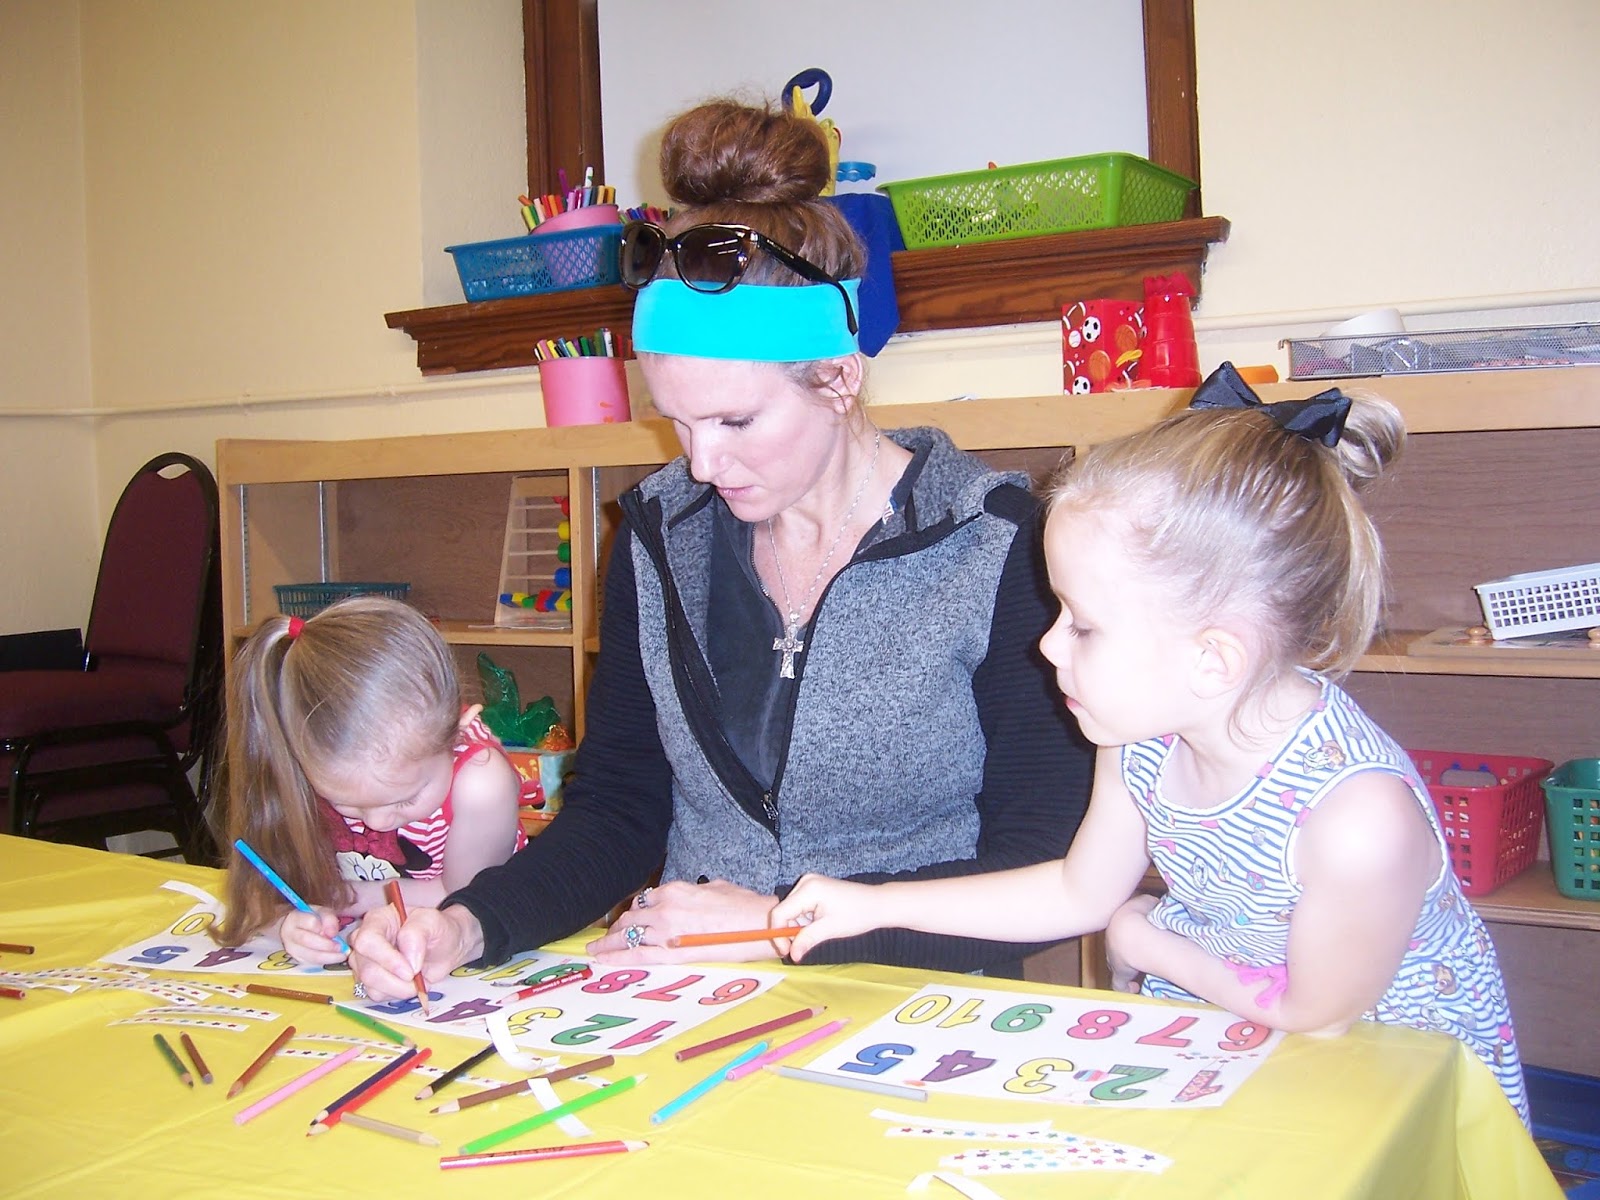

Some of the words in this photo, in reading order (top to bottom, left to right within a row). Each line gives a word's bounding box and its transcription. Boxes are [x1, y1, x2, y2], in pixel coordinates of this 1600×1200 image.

[128, 945, 189, 964] 5
[194, 947, 253, 967] 4
[581, 969, 650, 995] 8
[632, 974, 704, 1001] 7
[697, 978, 759, 1006] 6
[426, 997, 504, 1024] 4
[895, 994, 984, 1029] 10
[991, 1002, 1053, 1033] 9
[1066, 1009, 1133, 1040] 8
[551, 1013, 639, 1046] 2
[608, 1020, 678, 1050] 1
[1135, 1015, 1198, 1048] 7
[1218, 1020, 1272, 1052] 6
[838, 1043, 914, 1076] 5
[921, 1049, 997, 1083] 4
[1003, 1057, 1076, 1095] 3
[1089, 1063, 1169, 1101] 2
[1172, 1069, 1224, 1103] 1
